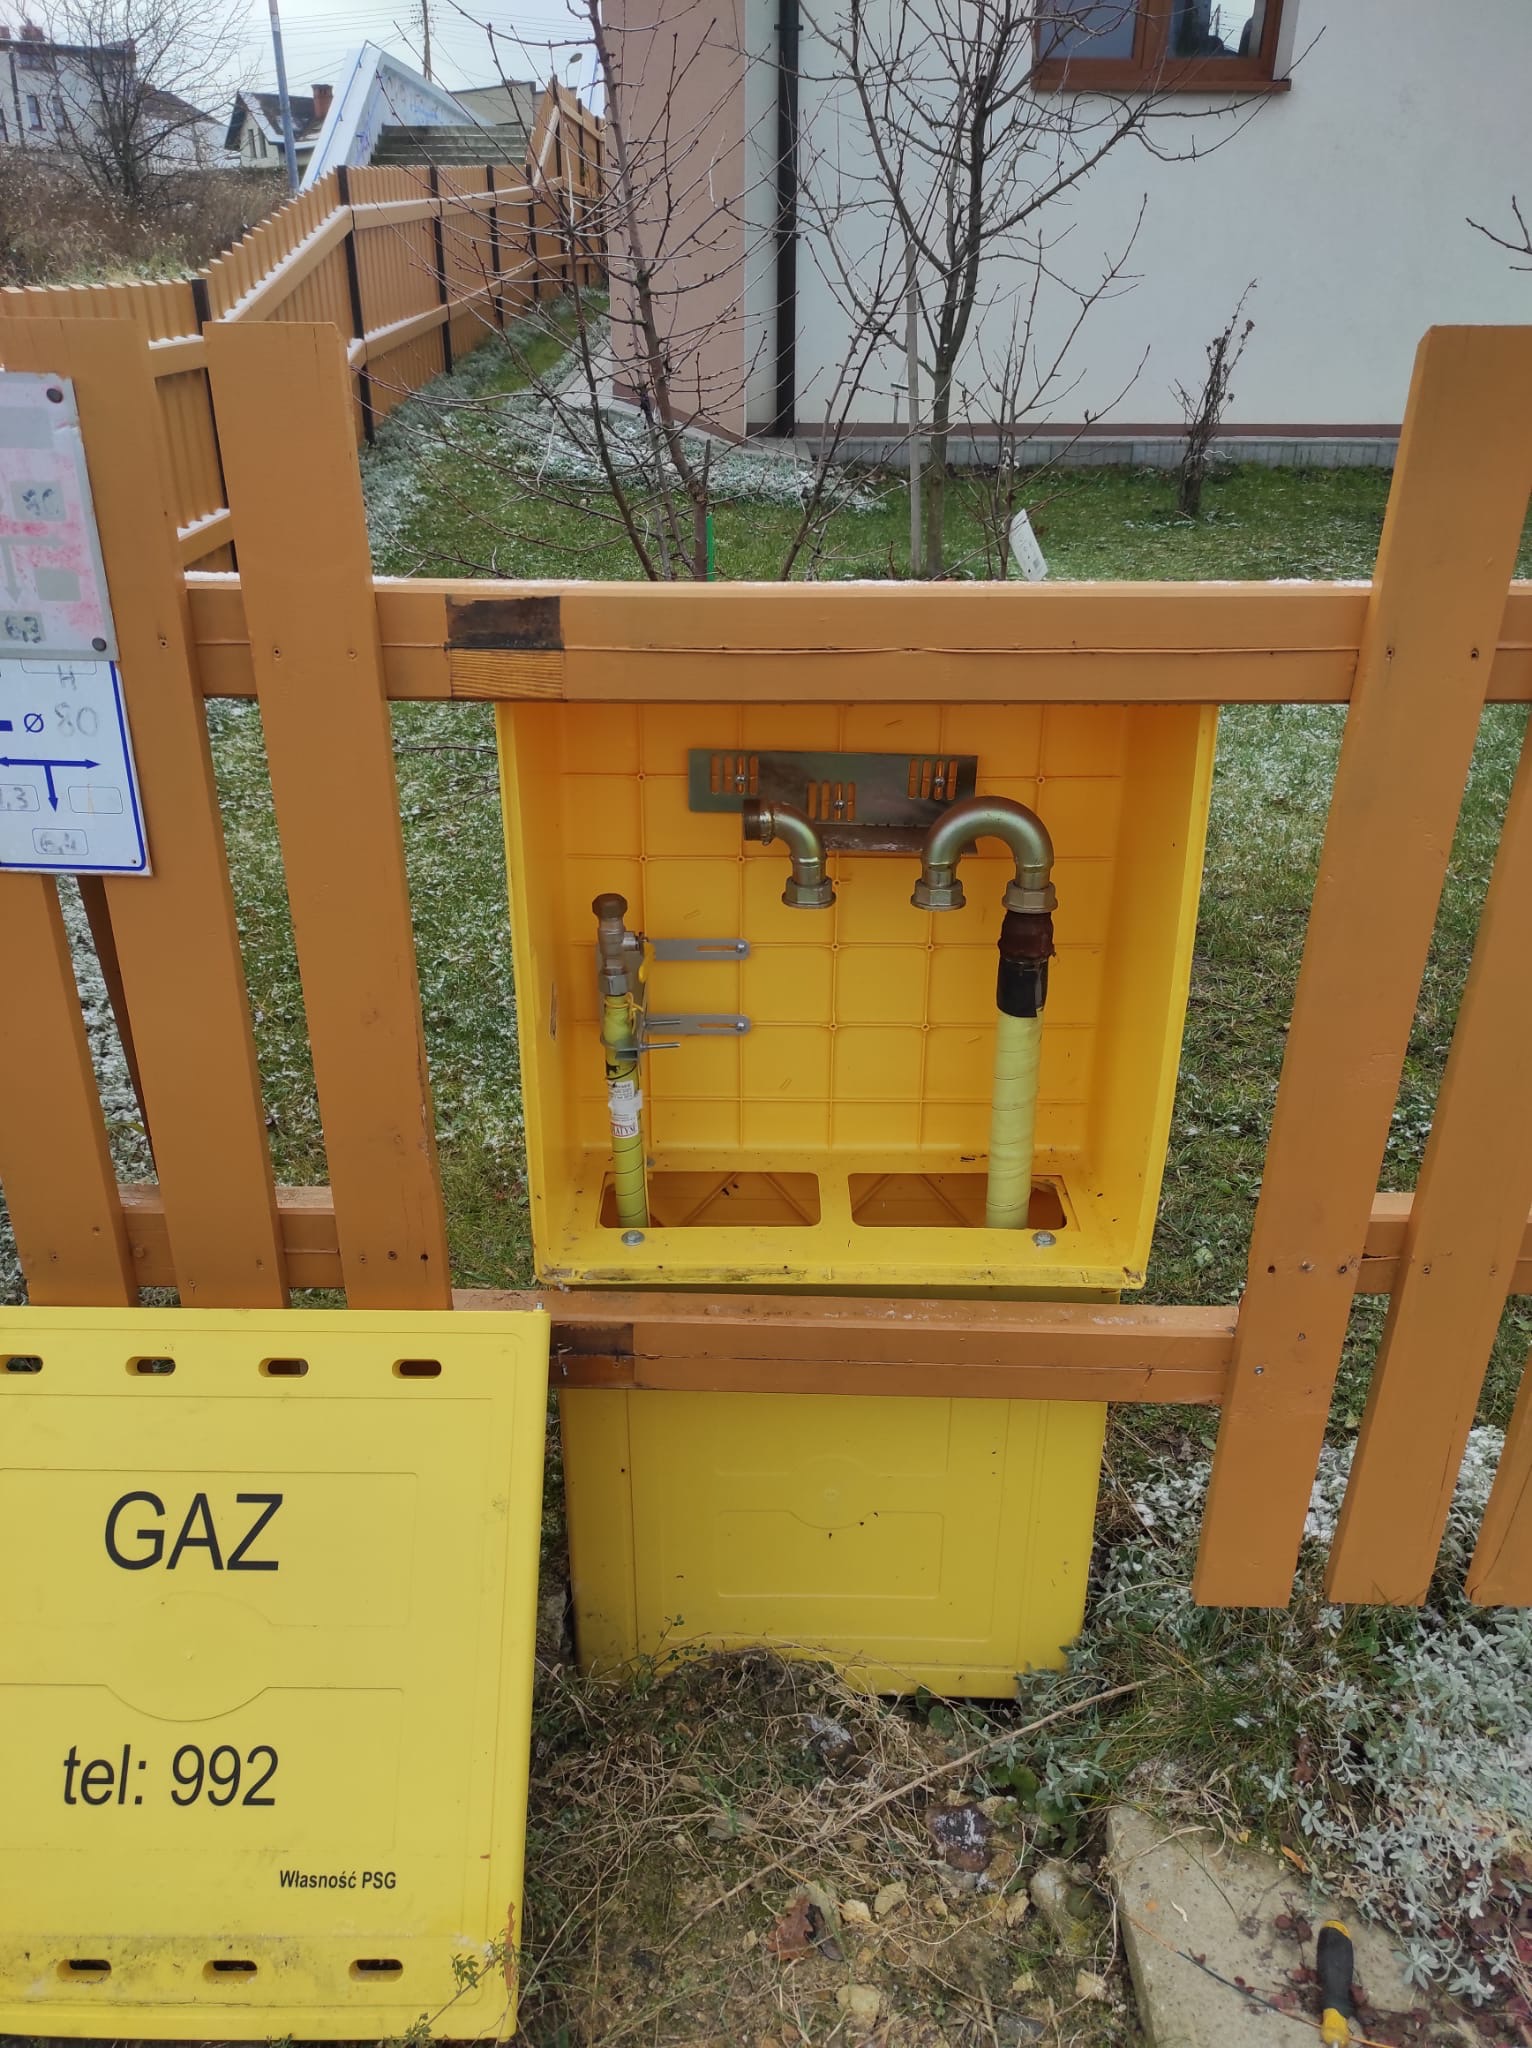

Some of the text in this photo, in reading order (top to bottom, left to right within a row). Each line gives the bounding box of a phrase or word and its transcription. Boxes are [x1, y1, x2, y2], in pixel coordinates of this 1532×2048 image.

[104, 1490, 284, 1571] GAZ
[63, 1743, 279, 1807] tel: 992
[279, 1870, 396, 1889] Własność PSG
